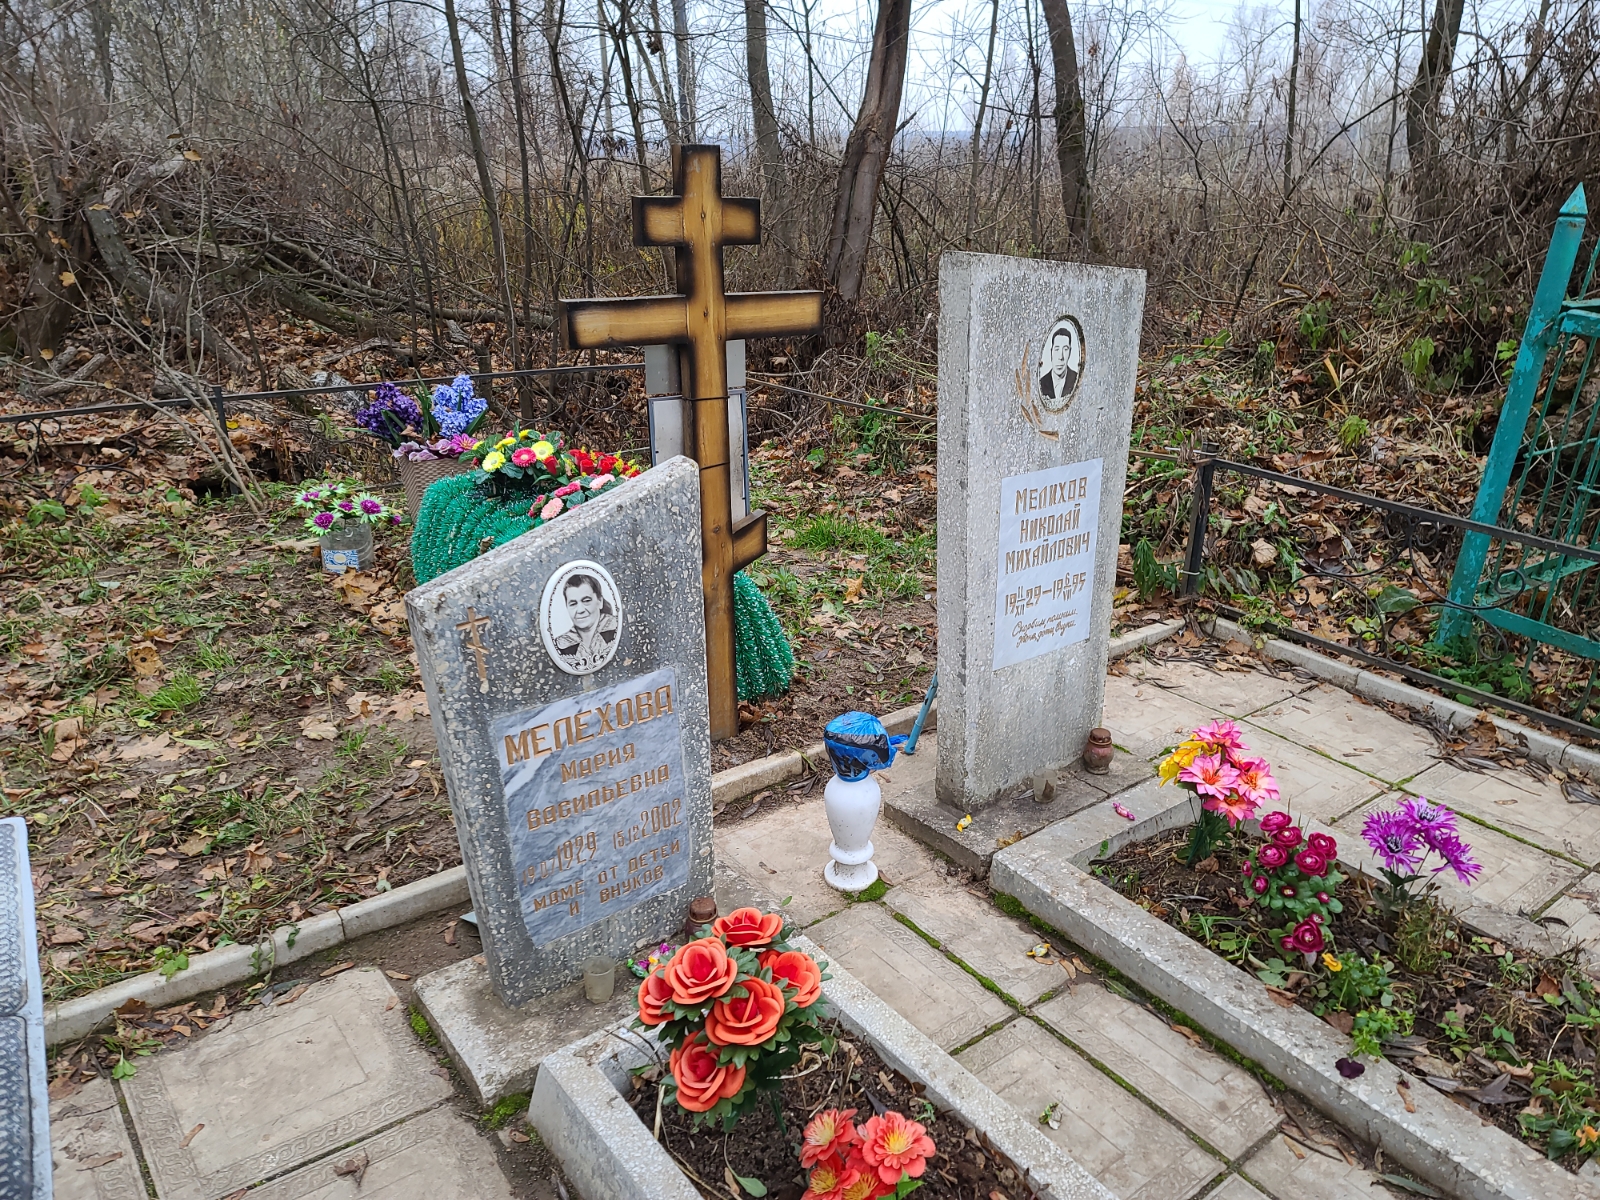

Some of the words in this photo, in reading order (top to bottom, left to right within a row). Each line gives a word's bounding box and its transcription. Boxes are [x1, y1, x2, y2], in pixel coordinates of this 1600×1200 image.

[1015, 476, 1087, 515] МЕЛИХОВ
[1019, 502, 1081, 544] НИКОЛАЙ
[1005, 531, 1090, 575] МИХАЙЛОВИЧ
[504, 685, 673, 766] МЕЛЕХОВА
[560, 742, 636, 784] МАРИЯ
[526, 764, 670, 831] ВАСИЛЬЕВНА
[533, 879, 585, 912] МАМЕ
[597, 865, 618, 885] ОТ
[628, 837, 681, 874] ДЕТЕЙ
[569, 900, 580, 917] И
[600, 865, 664, 903] ВНУКОВ
